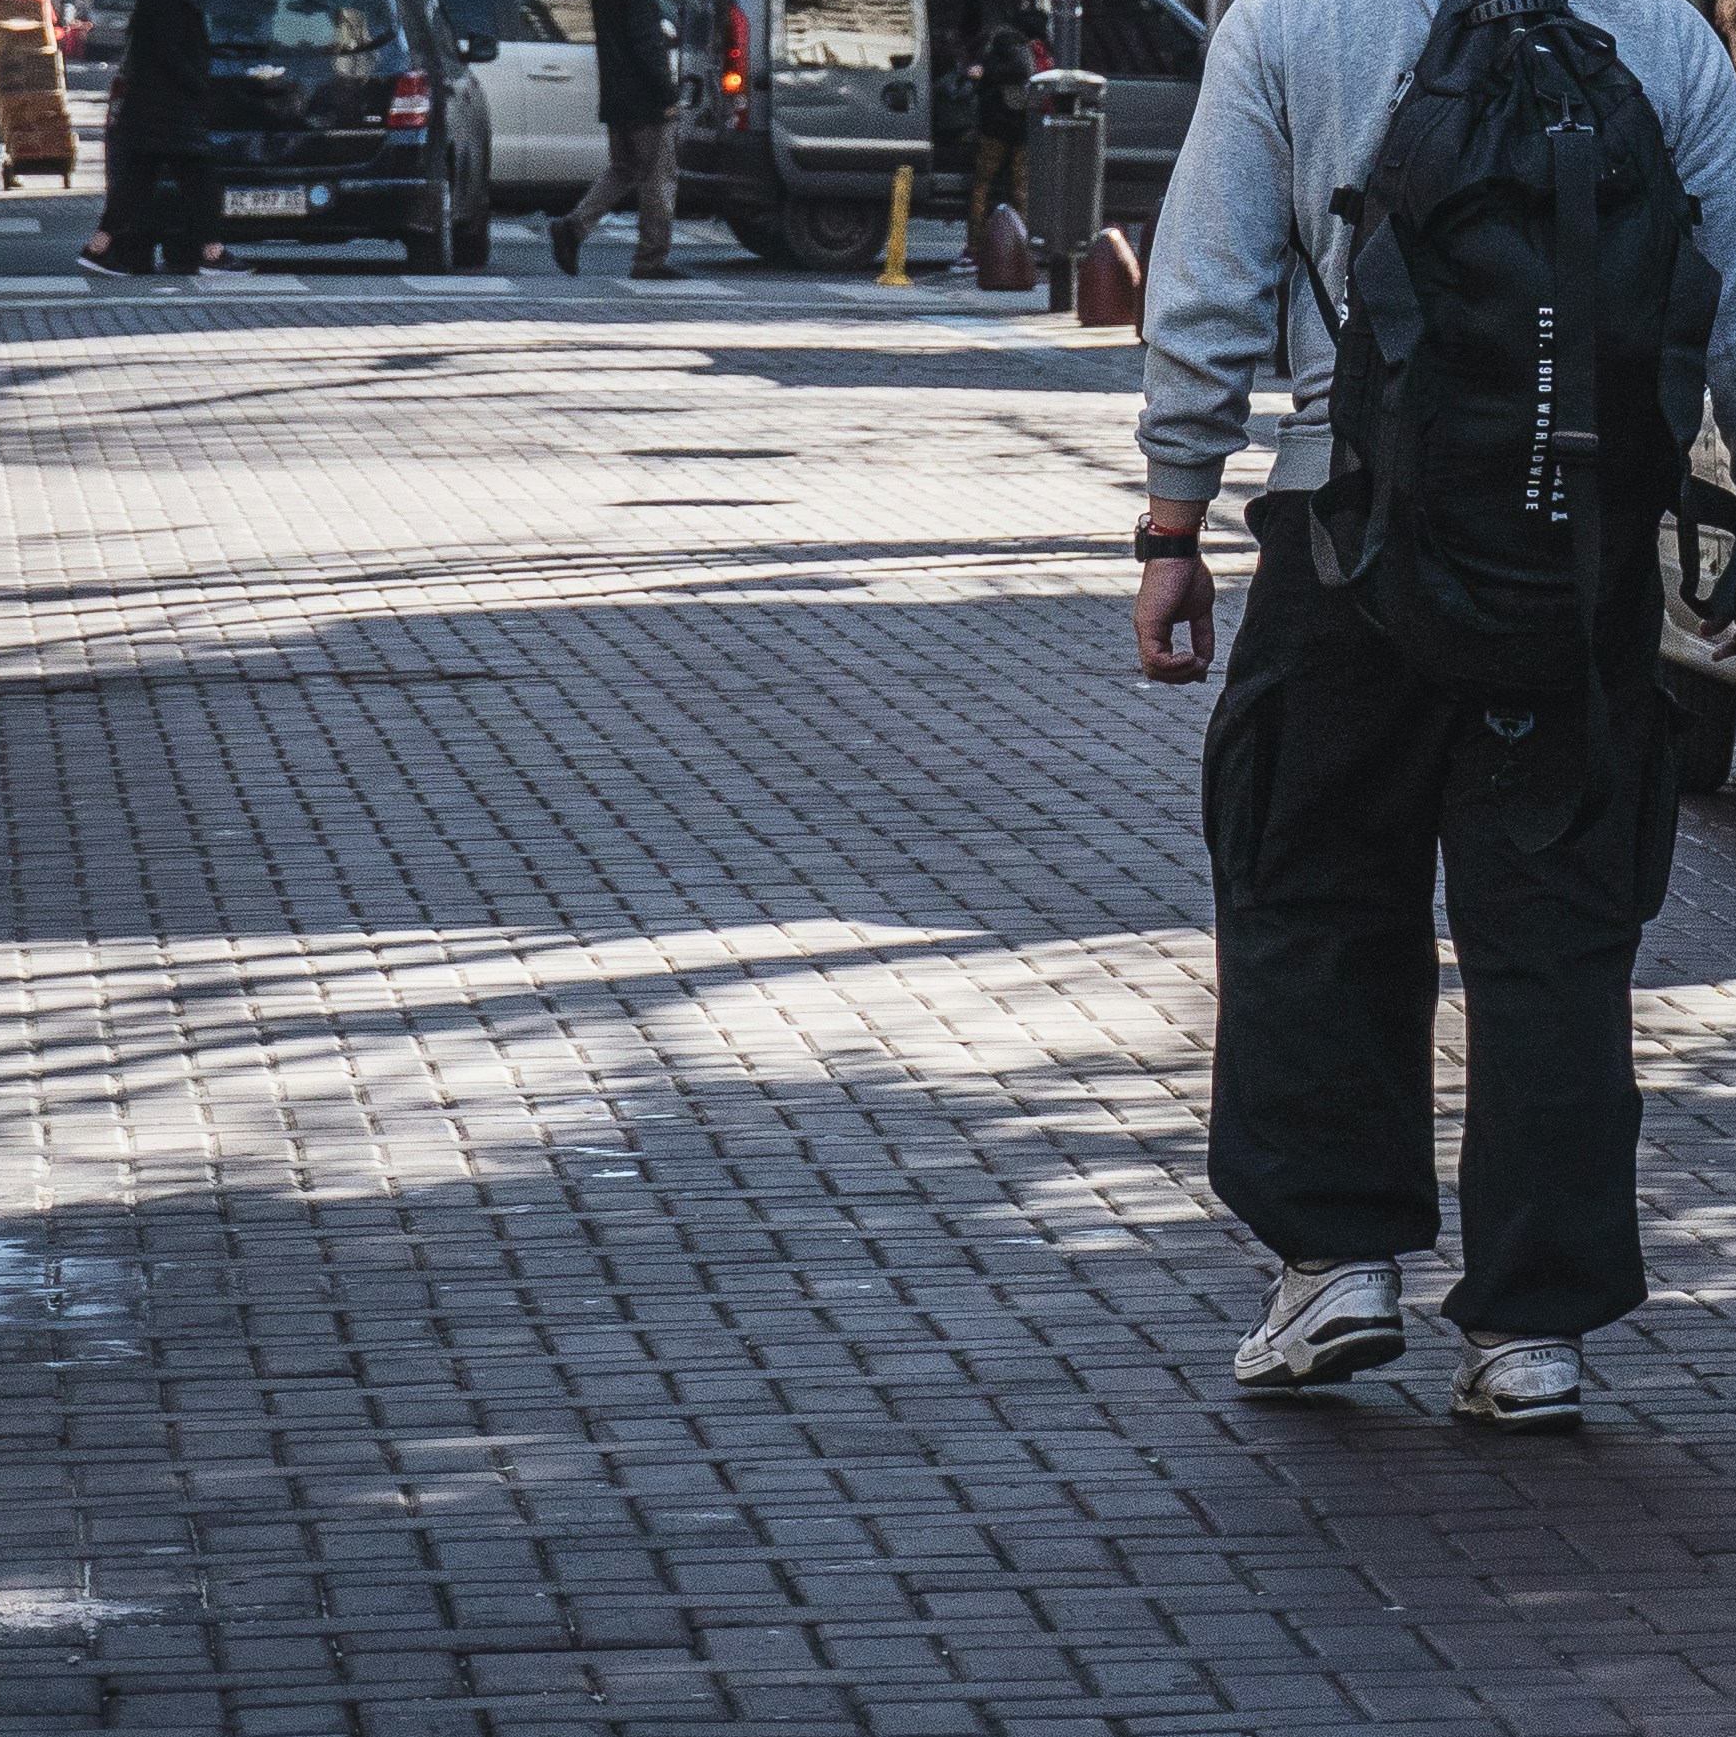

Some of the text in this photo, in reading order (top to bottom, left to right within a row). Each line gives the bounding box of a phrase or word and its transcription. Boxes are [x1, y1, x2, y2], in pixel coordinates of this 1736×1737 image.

[1525, 307, 1553, 510] EST. 1910 WORLDWIDE
